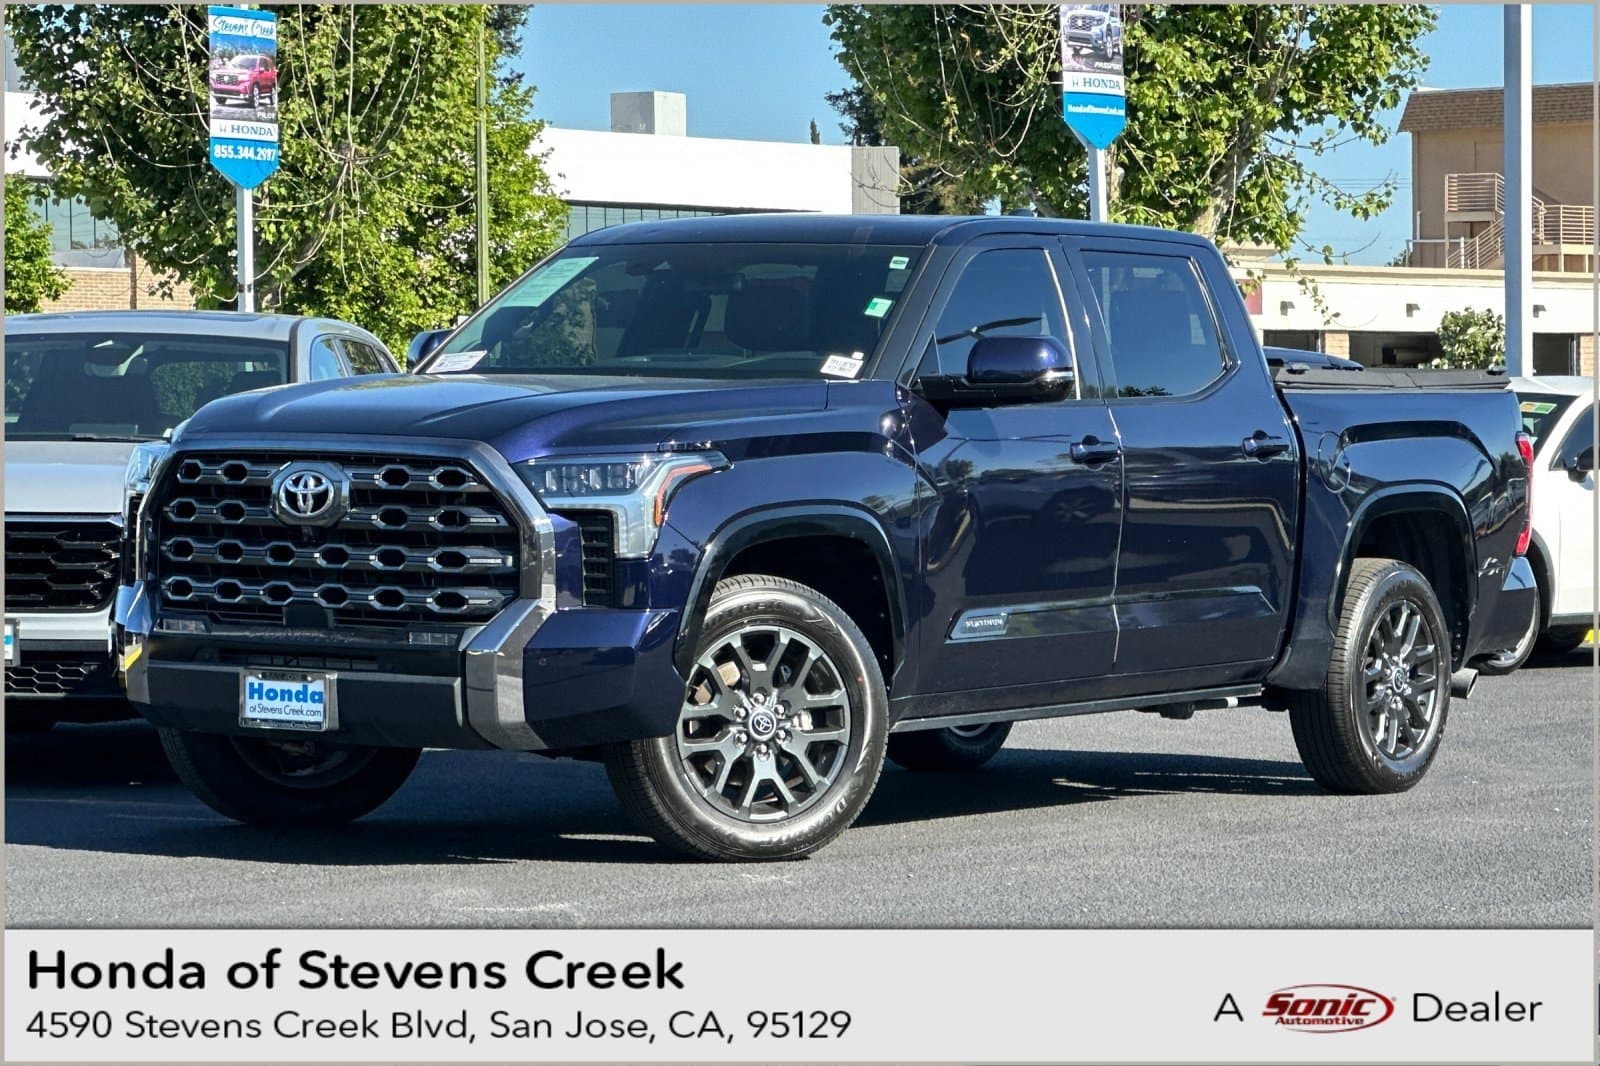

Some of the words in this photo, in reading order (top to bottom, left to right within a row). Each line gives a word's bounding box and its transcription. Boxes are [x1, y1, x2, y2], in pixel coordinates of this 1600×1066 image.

[1082, 77, 1121, 91] HONDA
[231, 124, 274, 137] HONDA
[248, 682, 325, 704] Honda
[257, 703, 283, 715] Stevens
